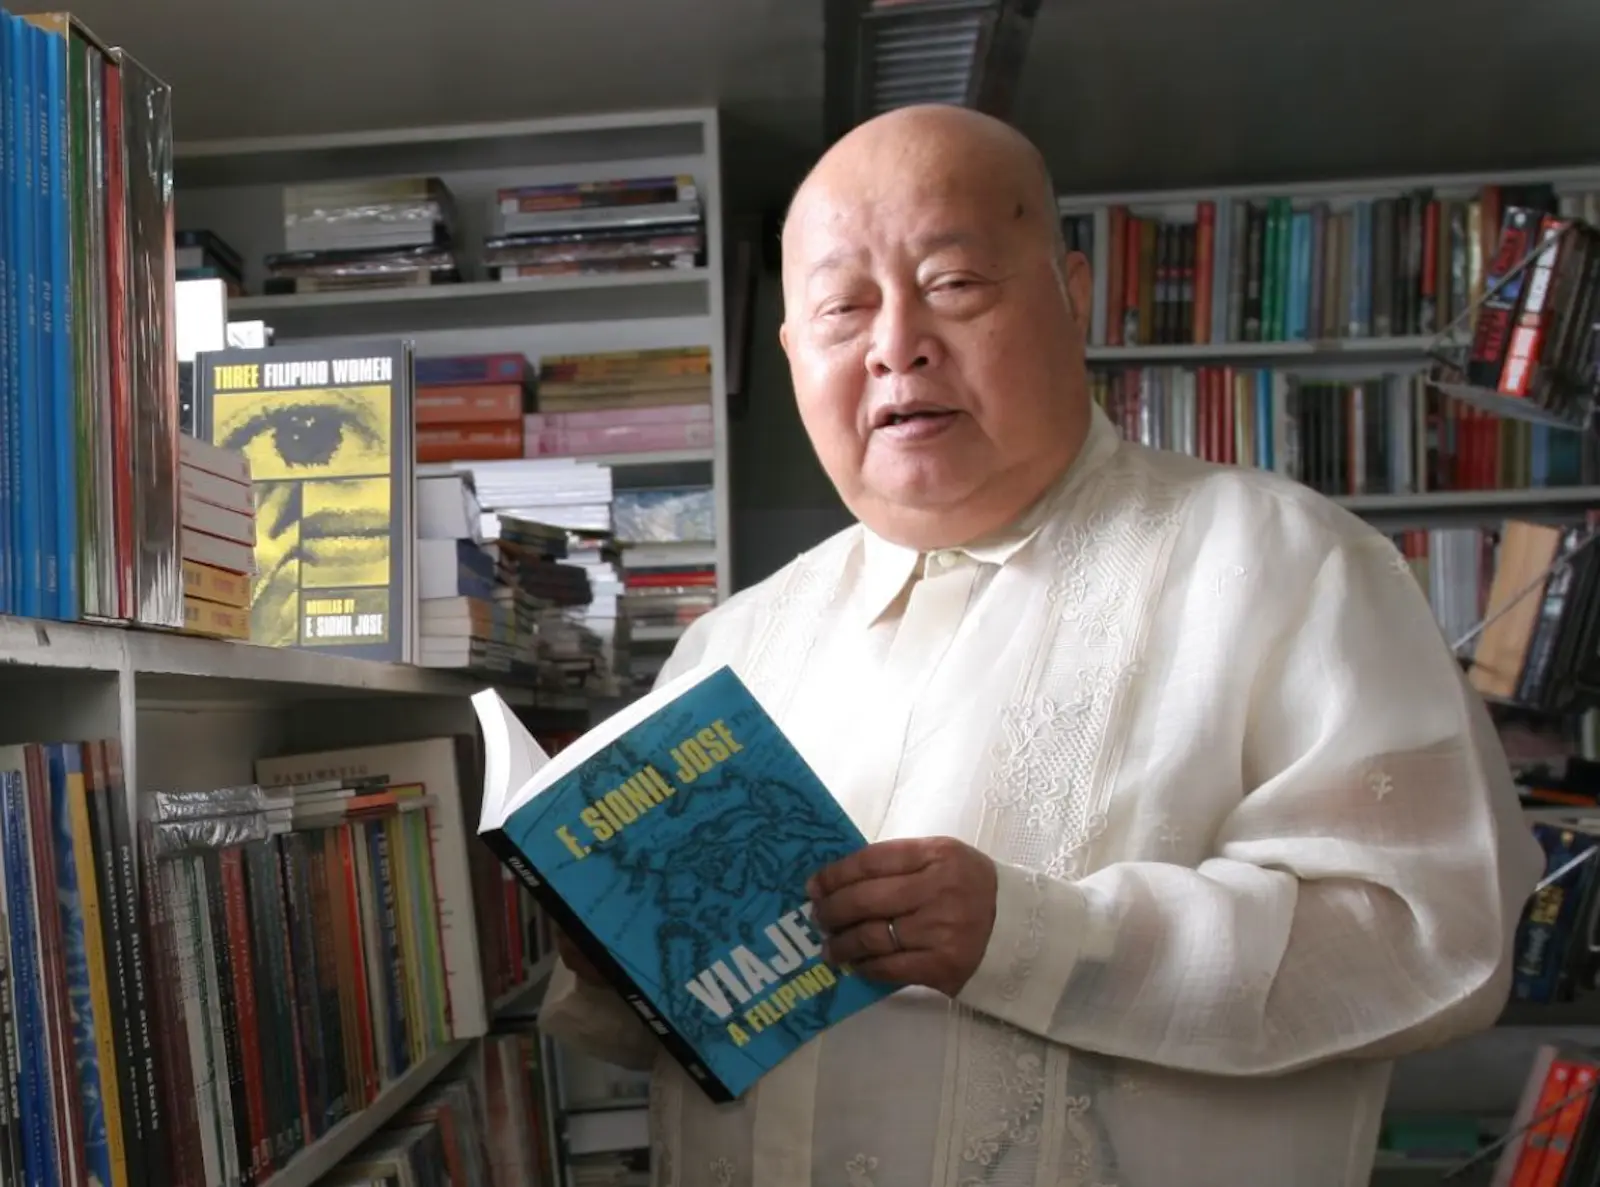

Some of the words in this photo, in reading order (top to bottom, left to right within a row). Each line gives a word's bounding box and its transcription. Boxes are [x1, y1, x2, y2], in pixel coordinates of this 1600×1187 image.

[213, 364, 260, 390] THREE
[263, 360, 329, 388] FILIPINO
[332, 356, 393, 385] WOMEN
[355, 613, 383, 636] JOSE
[555, 823, 593, 861] F.
[579, 763, 678, 842] SIONIL
[669, 718, 746, 785] JOSE
[122, 845, 136, 925] Muslim
[131, 932, 145, 1001] Rulers
[139, 1008, 151, 1050] and
[684, 901, 824, 1020] VIAJE
[726, 1021, 751, 1048] A
[743, 962, 838, 1035] FILIPINO
